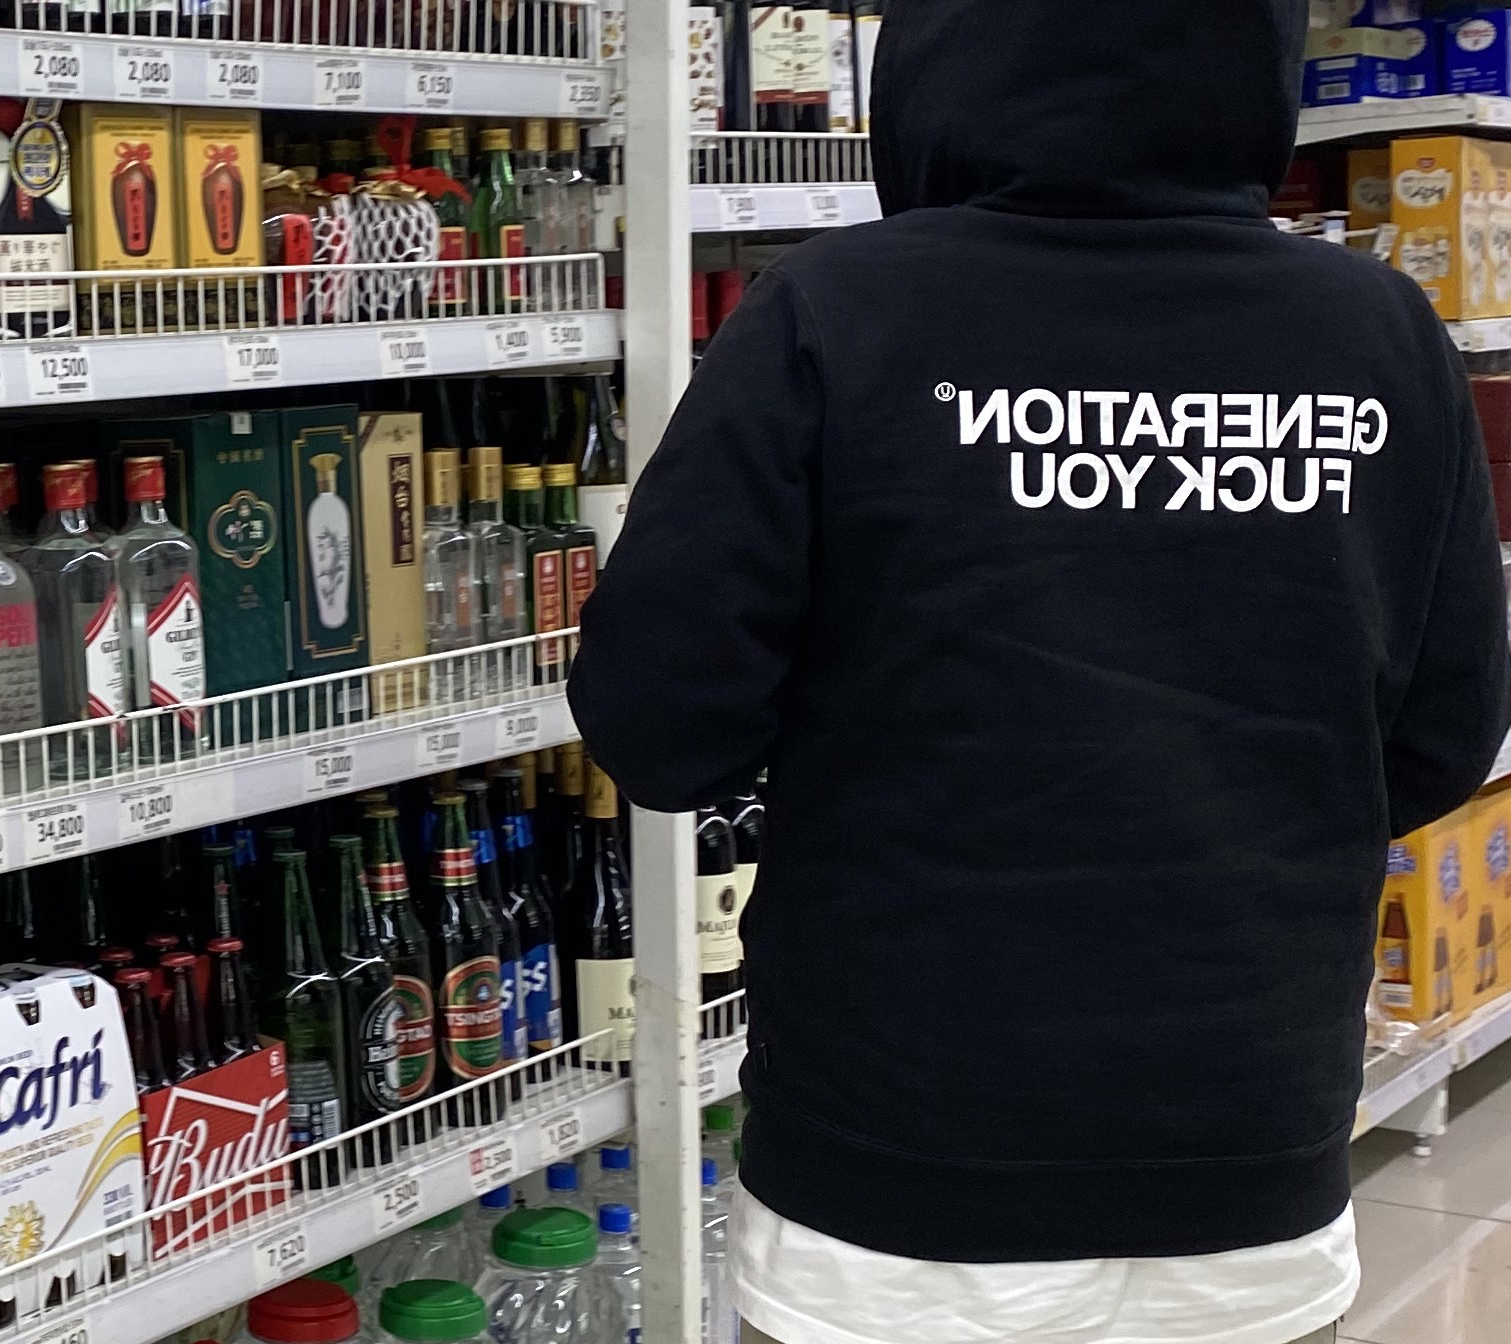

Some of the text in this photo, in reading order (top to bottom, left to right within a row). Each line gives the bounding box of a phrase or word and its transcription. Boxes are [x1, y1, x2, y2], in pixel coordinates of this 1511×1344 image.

[34, 55, 80, 80] 2,080
[128, 60, 171, 85] 2,080
[218, 64, 260, 88] 2,080
[41, 357, 89, 378] 12,500
[129, 796, 173, 822] 10,800
[38, 816, 84, 844] 34,800
[267, 1236, 307, 1268] 7,620
